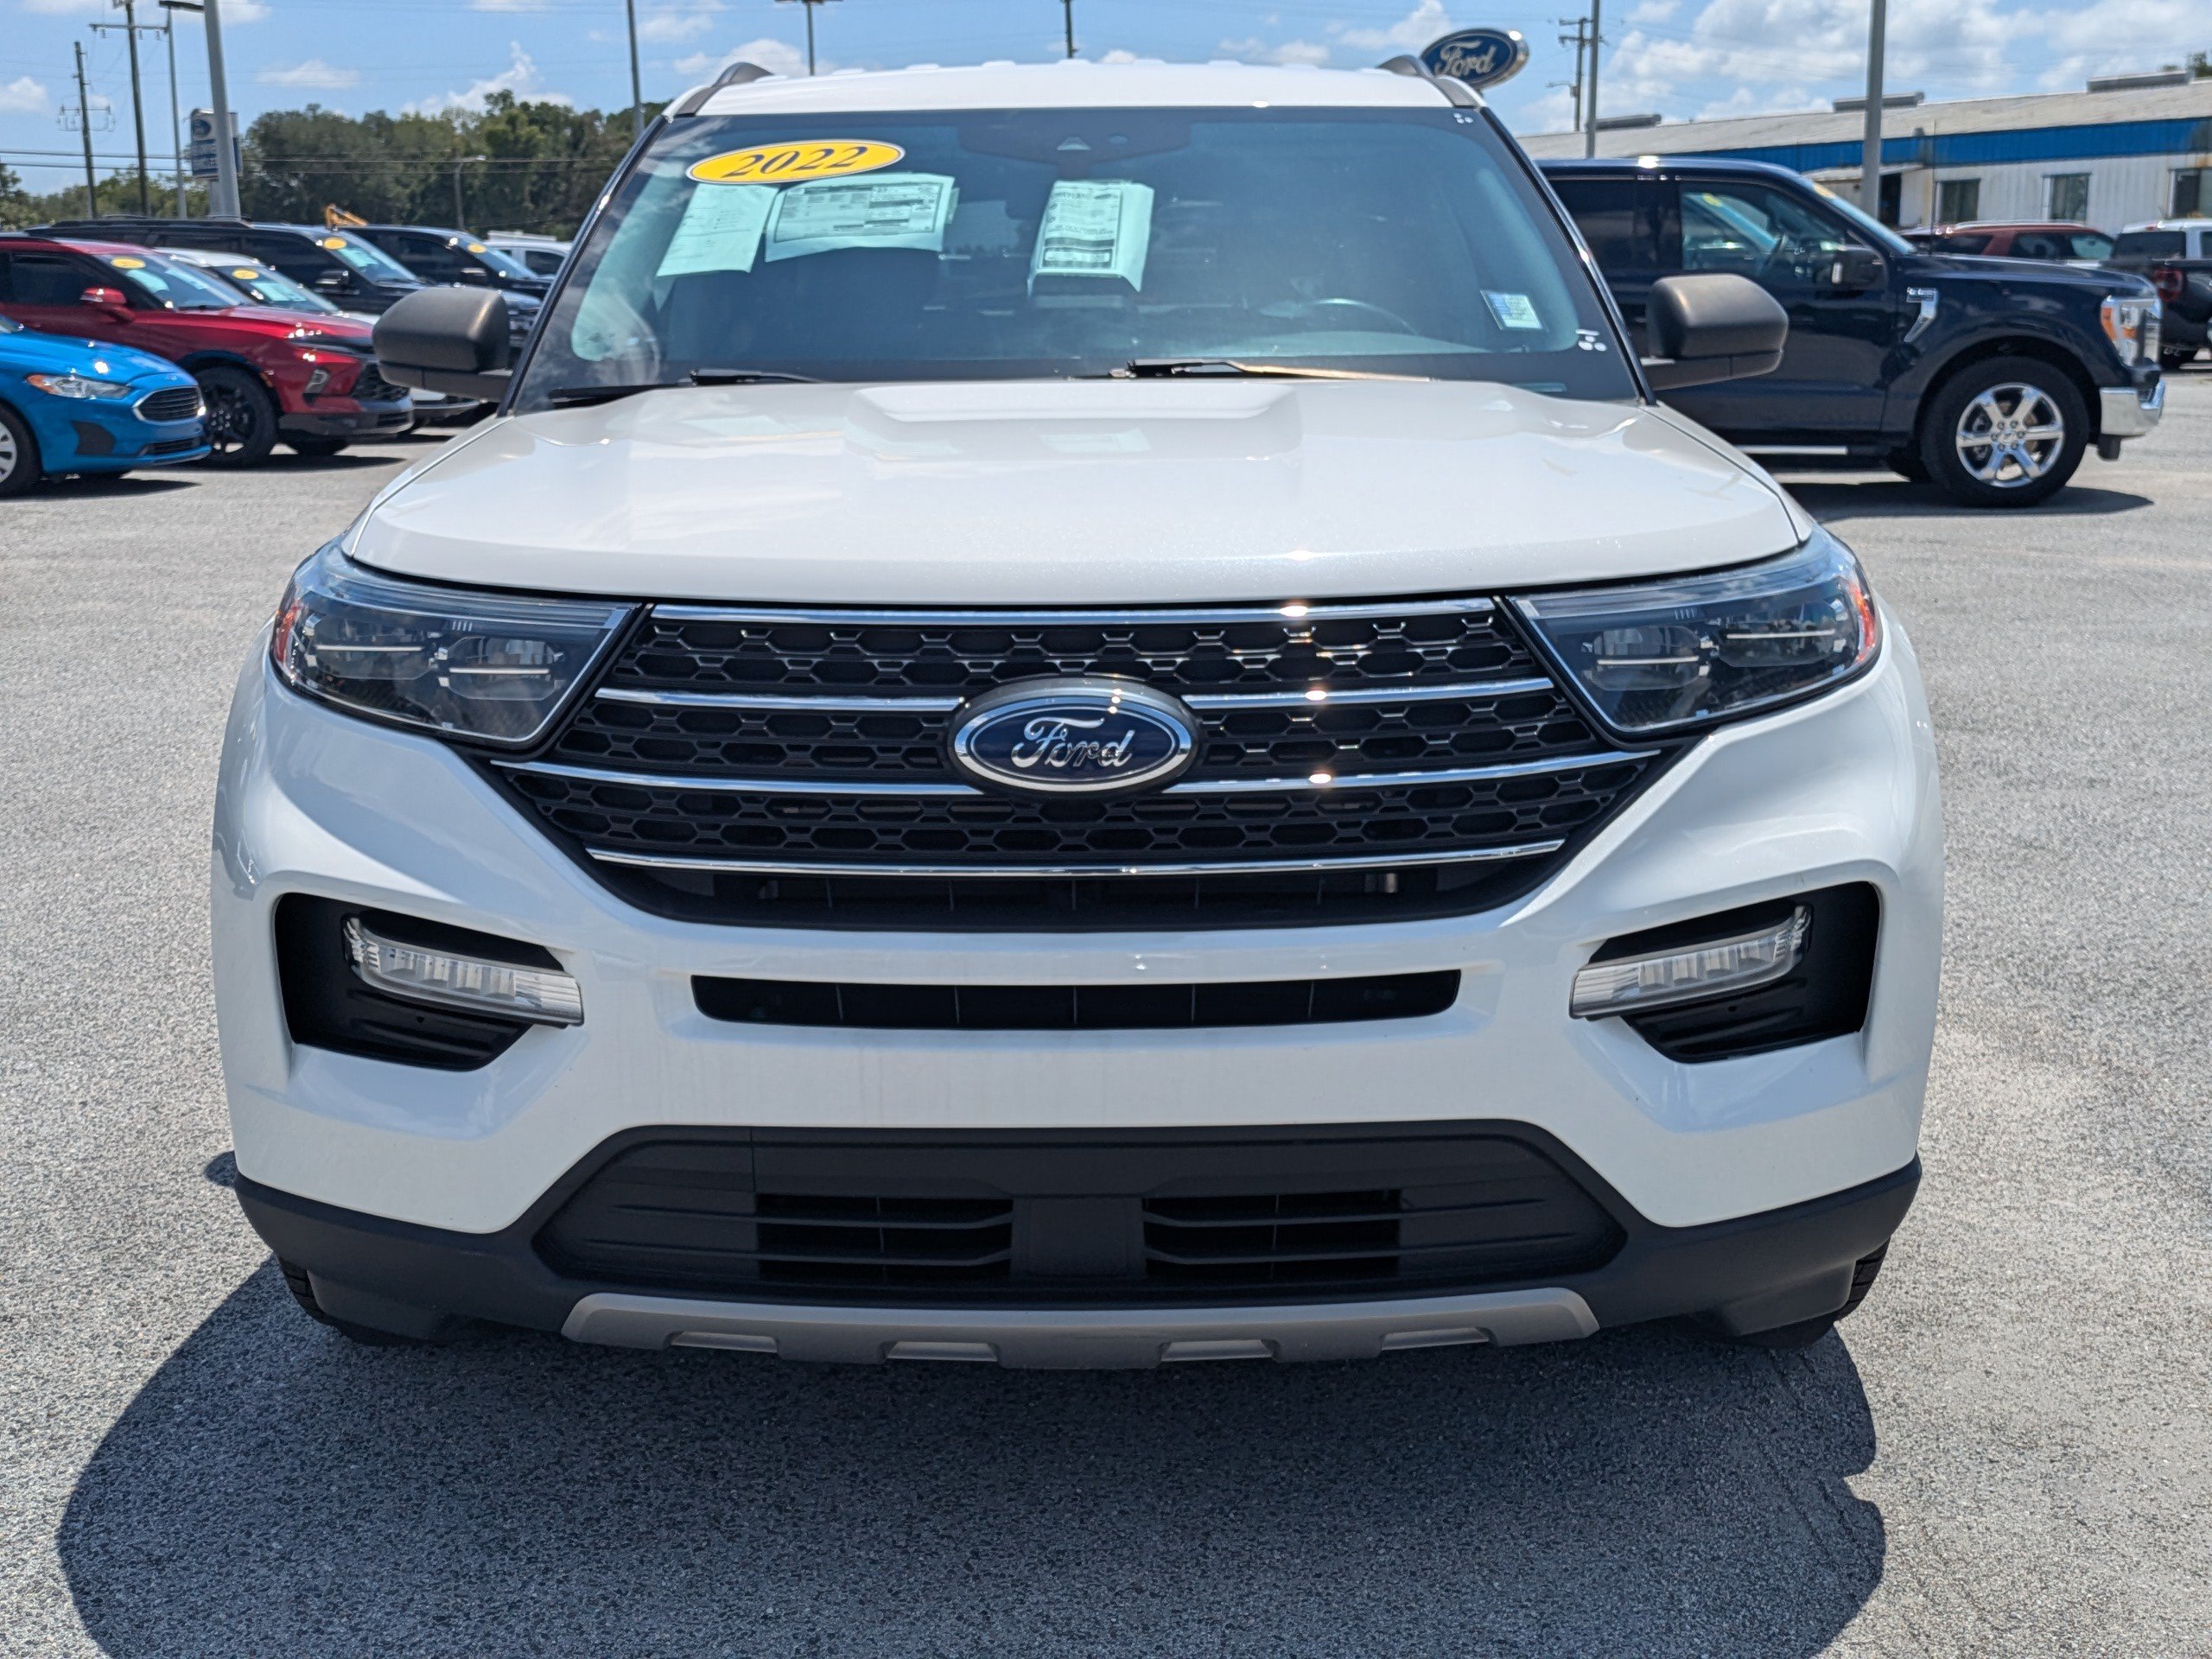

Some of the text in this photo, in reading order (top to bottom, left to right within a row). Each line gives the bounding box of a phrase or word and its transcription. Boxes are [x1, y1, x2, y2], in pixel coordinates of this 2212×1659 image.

[1434, 40, 1497, 77] Ford
[720, 145, 868, 178] 2022
[1011, 716, 1136, 768] Ford
